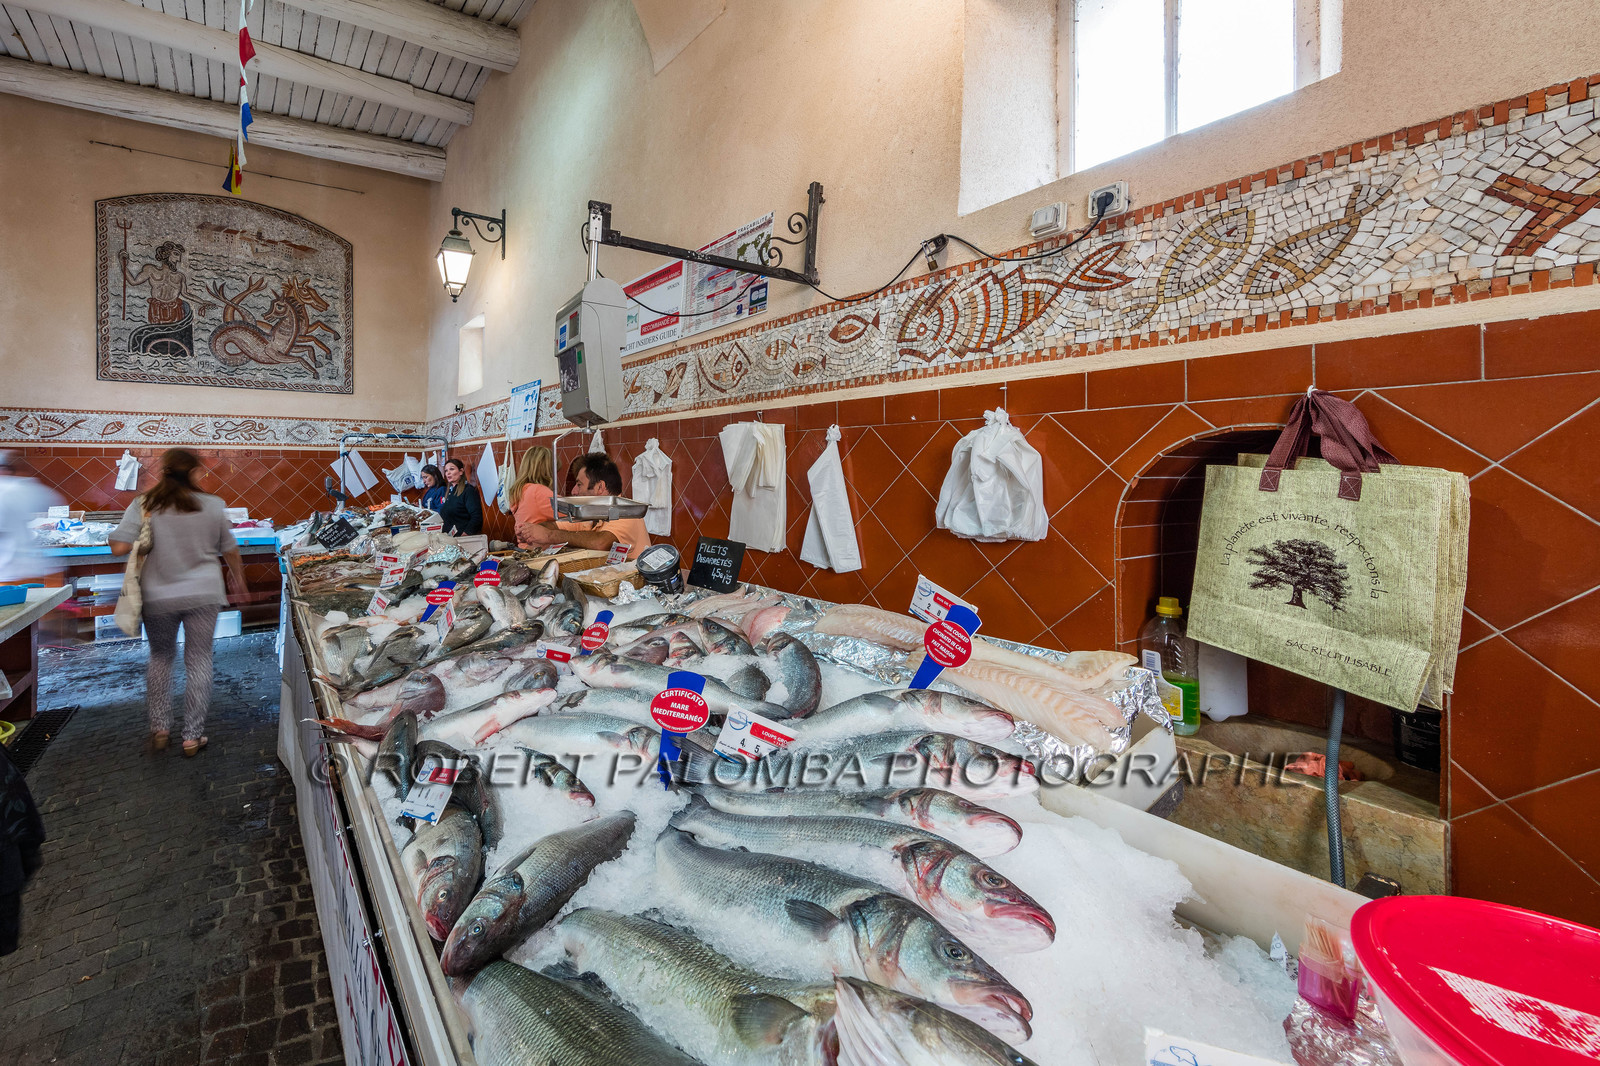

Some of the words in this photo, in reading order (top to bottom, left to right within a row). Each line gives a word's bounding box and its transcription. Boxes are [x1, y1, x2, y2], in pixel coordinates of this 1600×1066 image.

[660, 328, 677, 340] GUIDE
[1258, 512, 1279, 524] est
[1281, 512, 1330, 530] vivante,
[1223, 520, 1256, 554] planète
[699, 542, 728, 556] FILETS
[1334, 522, 1382, 586] respectons
[1220, 552, 1231, 566] La
[1370, 587, 1388, 599] la
[941, 622, 953, 632] HOME
[952, 628, 970, 643] COOKED
[932, 628, 951, 644] CUCINATO
[950, 639, 956, 647] IN
[955, 642, 966, 655] CASA
[1285, 638, 1309, 651] SAC
[931, 639, 940, 648] FAIT
[939, 644, 956, 659] MAISON
[660, 690, 704, 706] CERTIFICATO
[670, 702, 689, 711] MARE
[653, 707, 703, 723] MEDITERRANÉO
[762, 730, 777, 740] LOUPS
[754, 745, 760, 753] 5
